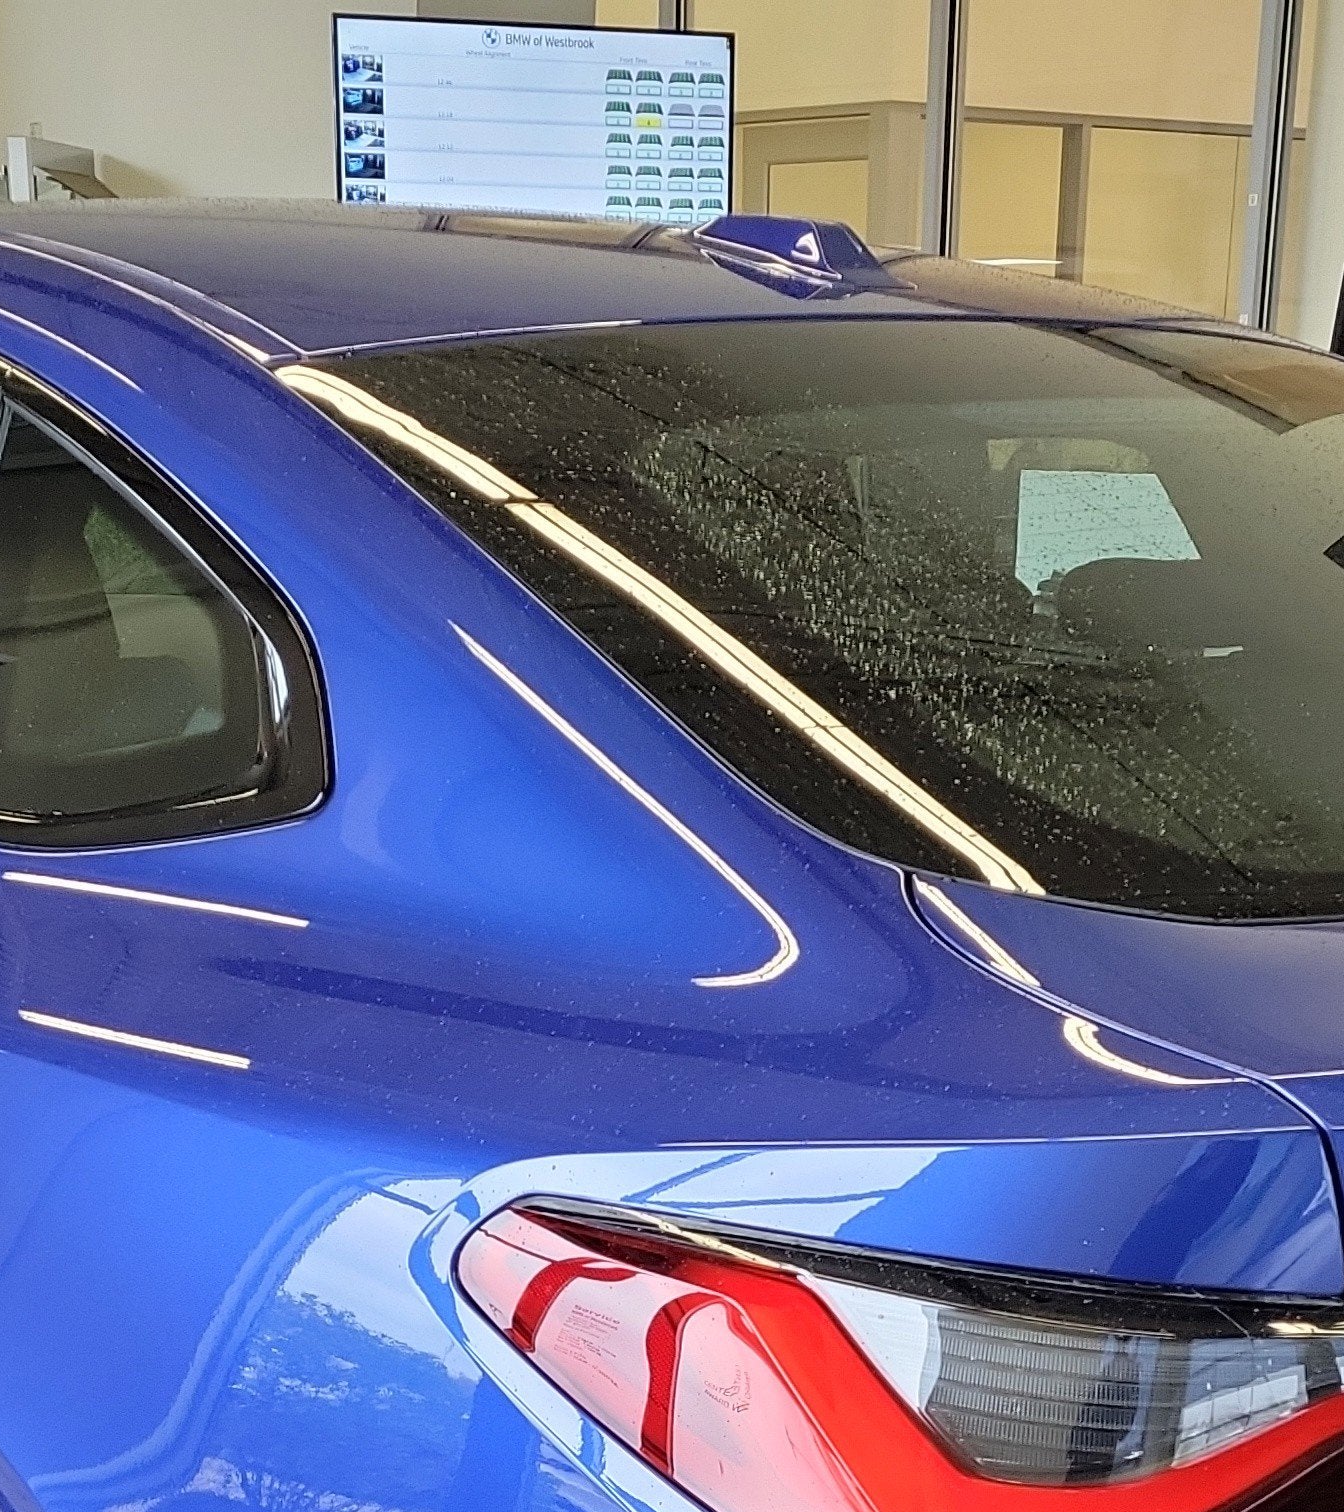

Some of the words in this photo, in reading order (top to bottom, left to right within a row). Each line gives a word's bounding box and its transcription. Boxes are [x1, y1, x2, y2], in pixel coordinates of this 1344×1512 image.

[505, 33, 531, 46] BMW
[533, 35, 543, 46] of
[544, 35, 595, 49] Westbrook
